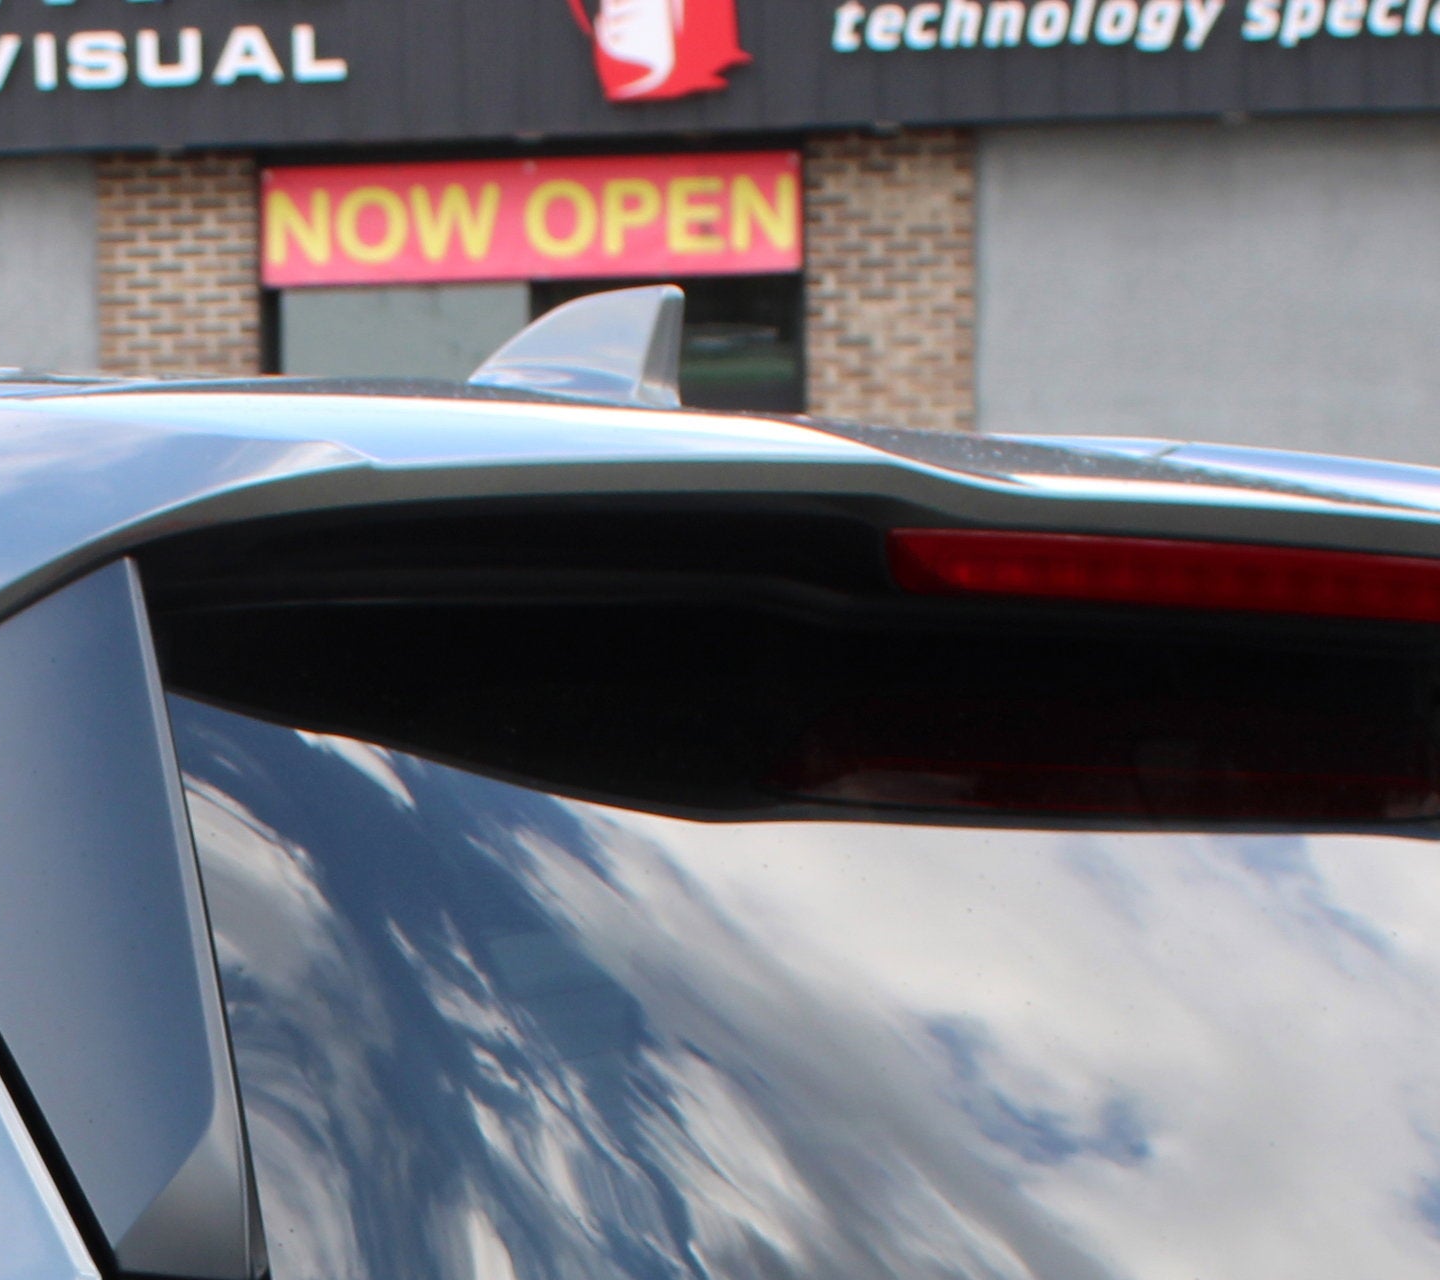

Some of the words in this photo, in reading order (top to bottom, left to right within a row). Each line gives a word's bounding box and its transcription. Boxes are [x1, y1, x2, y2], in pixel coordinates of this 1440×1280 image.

[831, 0, 1222, 52] technology
[265, 181, 501, 267] NOW
[524, 173, 797, 258] OPEN
